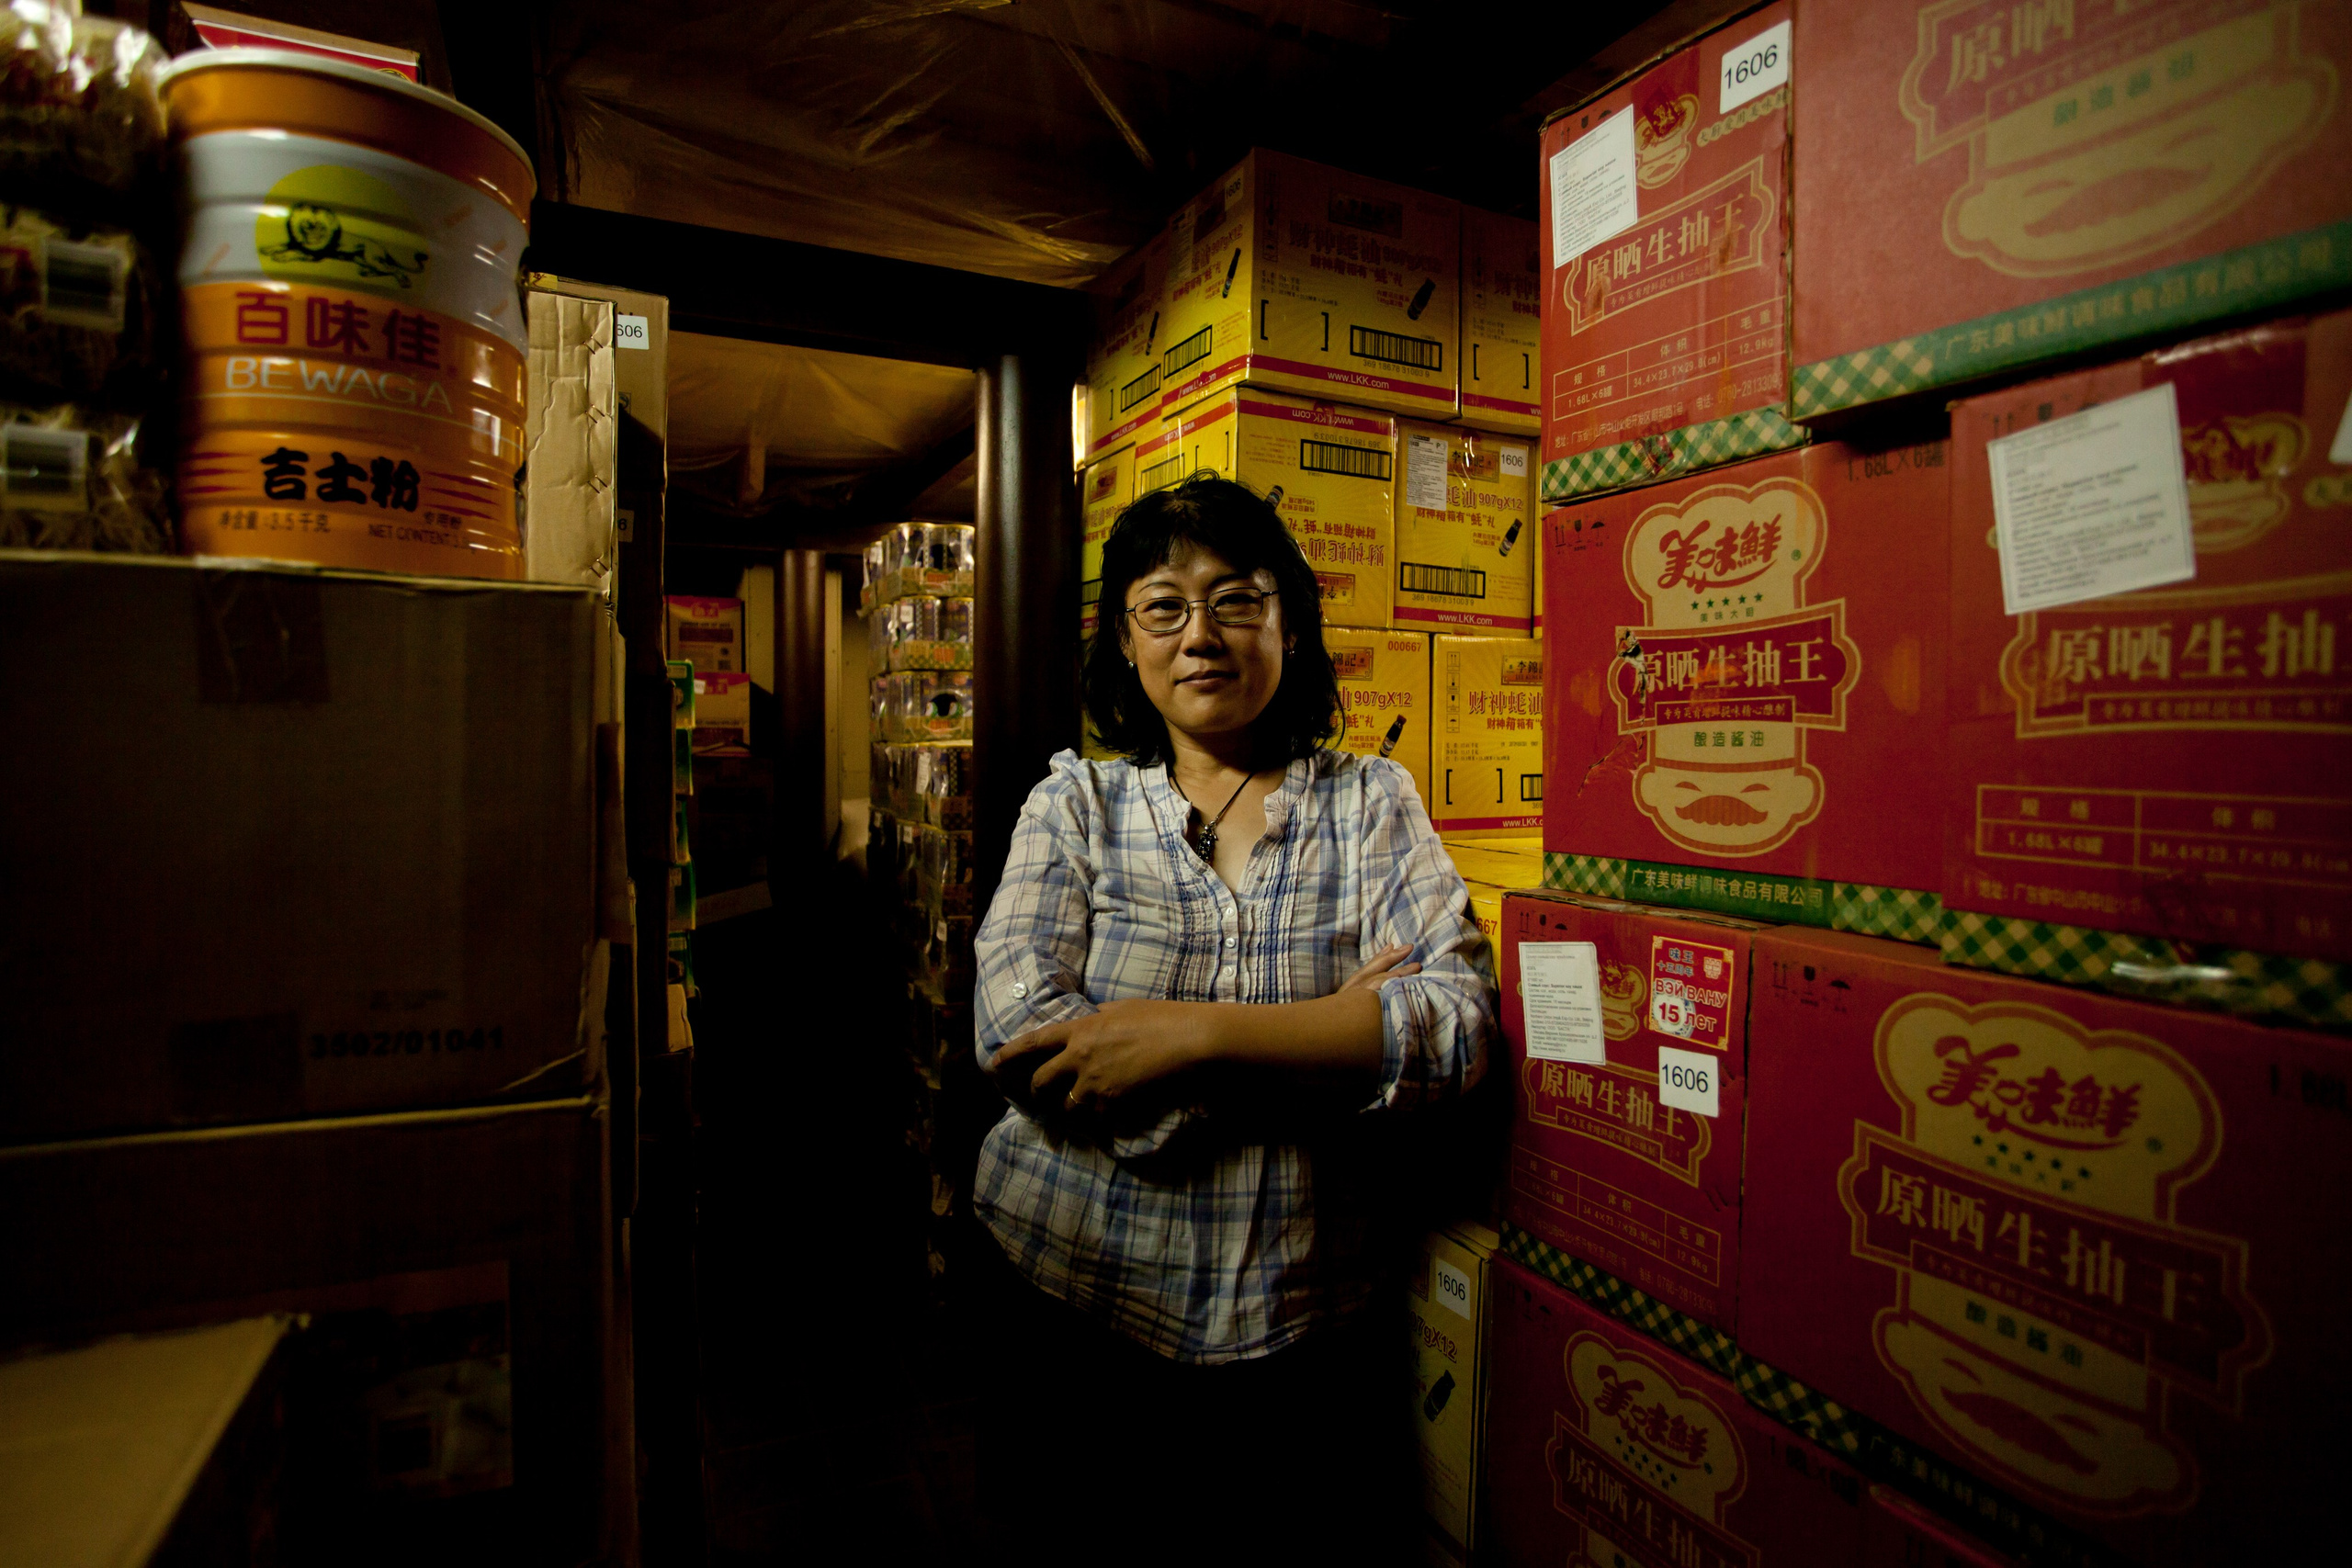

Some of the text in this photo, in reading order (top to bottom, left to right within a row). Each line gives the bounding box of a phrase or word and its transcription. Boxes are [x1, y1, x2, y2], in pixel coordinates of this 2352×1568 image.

[1724, 44, 1778, 90] 1606
[1584, 193, 1746, 298] 原晒生抽王
[235, 292, 441, 370] 百味佳
[225, 355, 455, 413] BEWAGA
[1327, 371, 1390, 390] www.LKK.com
[1501, 454, 1523, 468] 1606
[261, 447, 422, 512] 吉士粉
[1478, 492, 1524, 512] 907gX12
[1438, 613, 1493, 626] www.LKK.com
[1387, 640, 1422, 652] 000667
[2048, 608, 2352, 683] 原晒生抽
[1632, 636, 1827, 694] 原晒生抽王
[1353, 690, 1413, 711] 907gX12
[1631, 868, 1824, 909] 广东美味鲜调味食品有限公司
[1655, 977, 1684, 998] ВЭЙ
[1658, 1001, 1680, 1024] 15
[1661, 1063, 1709, 1093] 1606
[1874, 1163, 2207, 1334] 原晒生抽王
[1438, 1270, 1466, 1301] 1606
